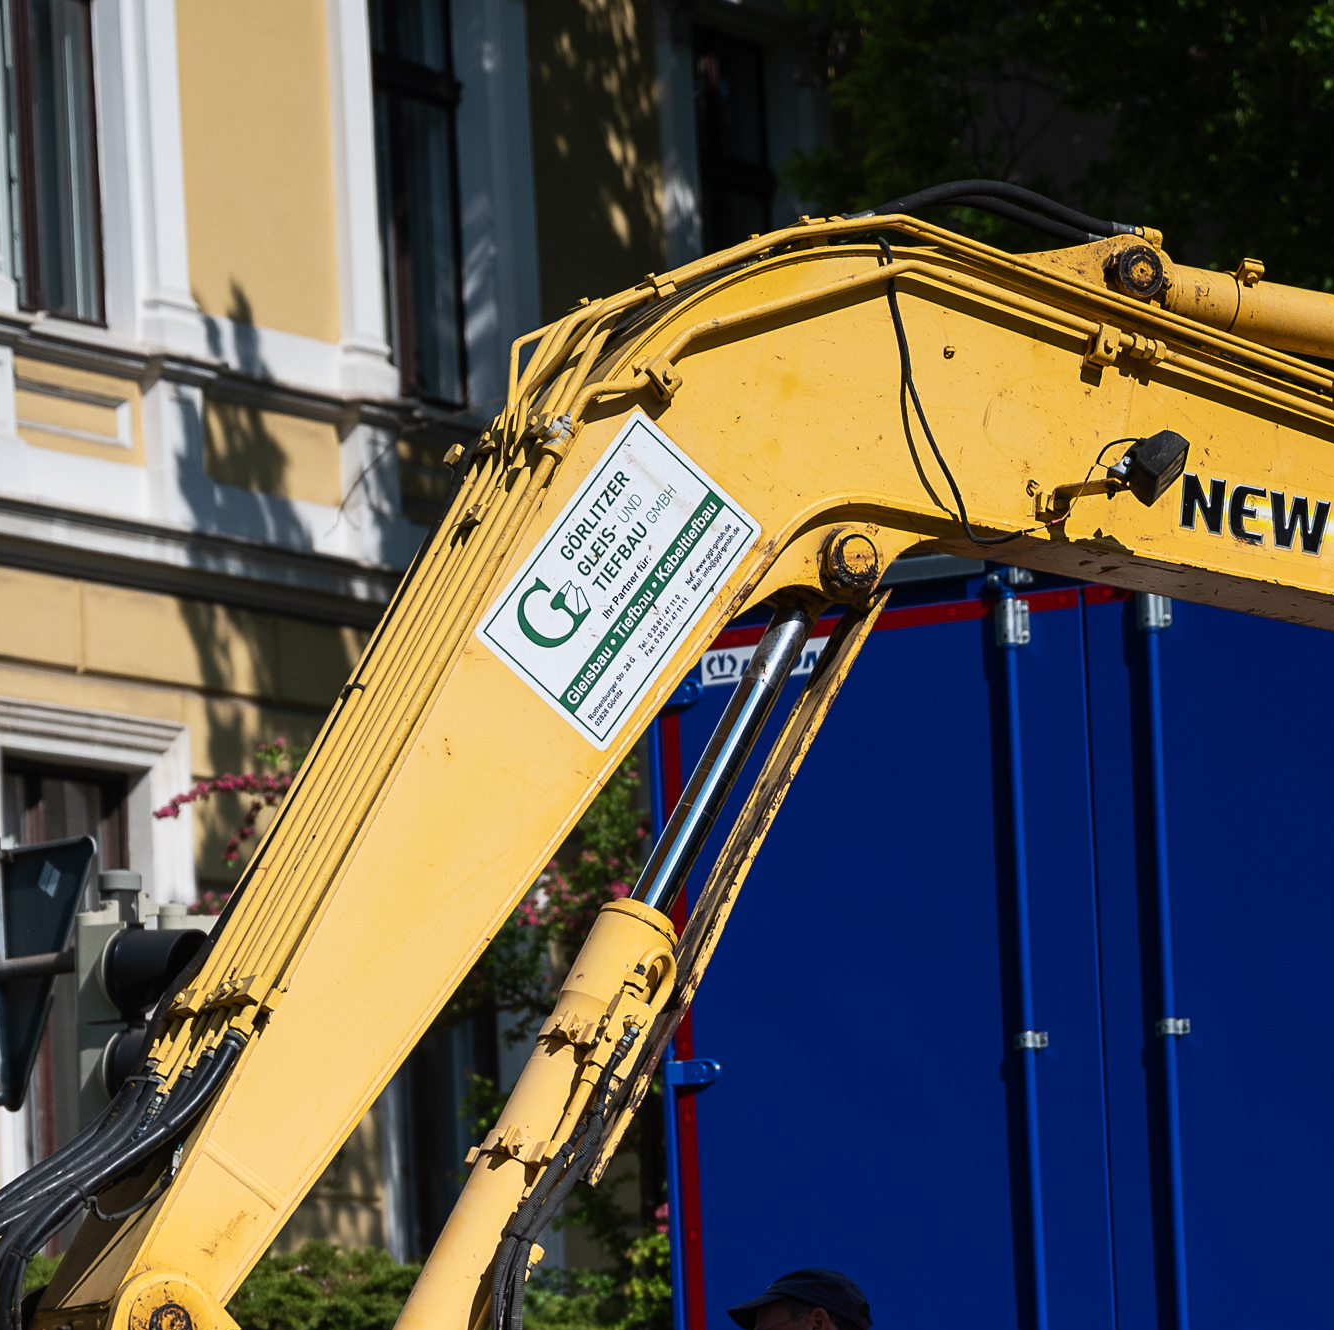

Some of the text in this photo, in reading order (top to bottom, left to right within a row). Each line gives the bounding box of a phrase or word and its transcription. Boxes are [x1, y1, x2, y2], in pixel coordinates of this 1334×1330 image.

[560, 471, 631, 560] GÖRLITZER
[577, 493, 643, 577] GLEIS- UND
[592, 483, 678, 591] TIEFBAU GMBH
[1178, 472, 1330, 556] NEW
[567, 501, 718, 705] Gleisbau Tiefbau Kabeltiefbau
[601, 555, 653, 620] Ihr Partner für:
[587, 680, 618, 721] Rothenburger
[615, 671, 627, 683] Str.
[607, 689, 624, 709] Görlitz
